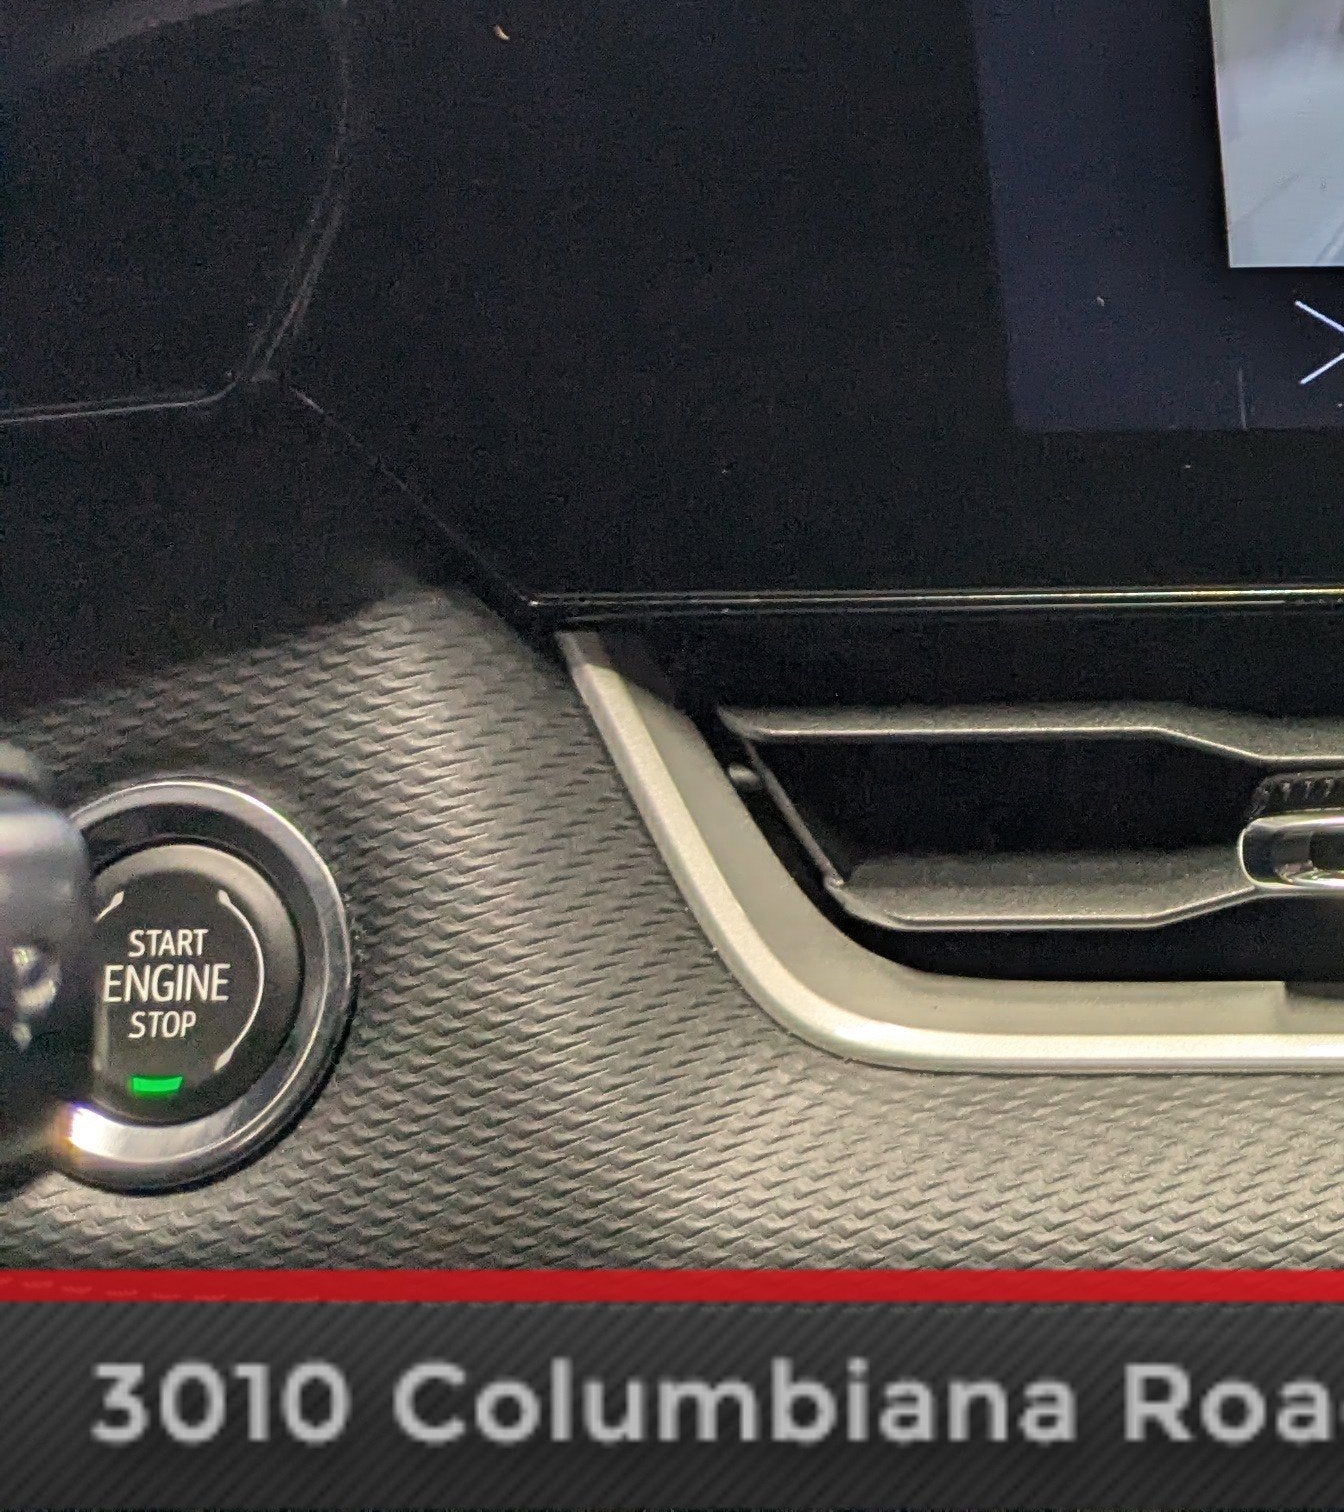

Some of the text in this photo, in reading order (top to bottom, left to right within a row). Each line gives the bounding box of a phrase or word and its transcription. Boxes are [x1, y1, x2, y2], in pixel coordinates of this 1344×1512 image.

[128, 928, 209, 958] START
[103, 963, 231, 1003] ENGINE
[127, 1010, 197, 1040] STOP
